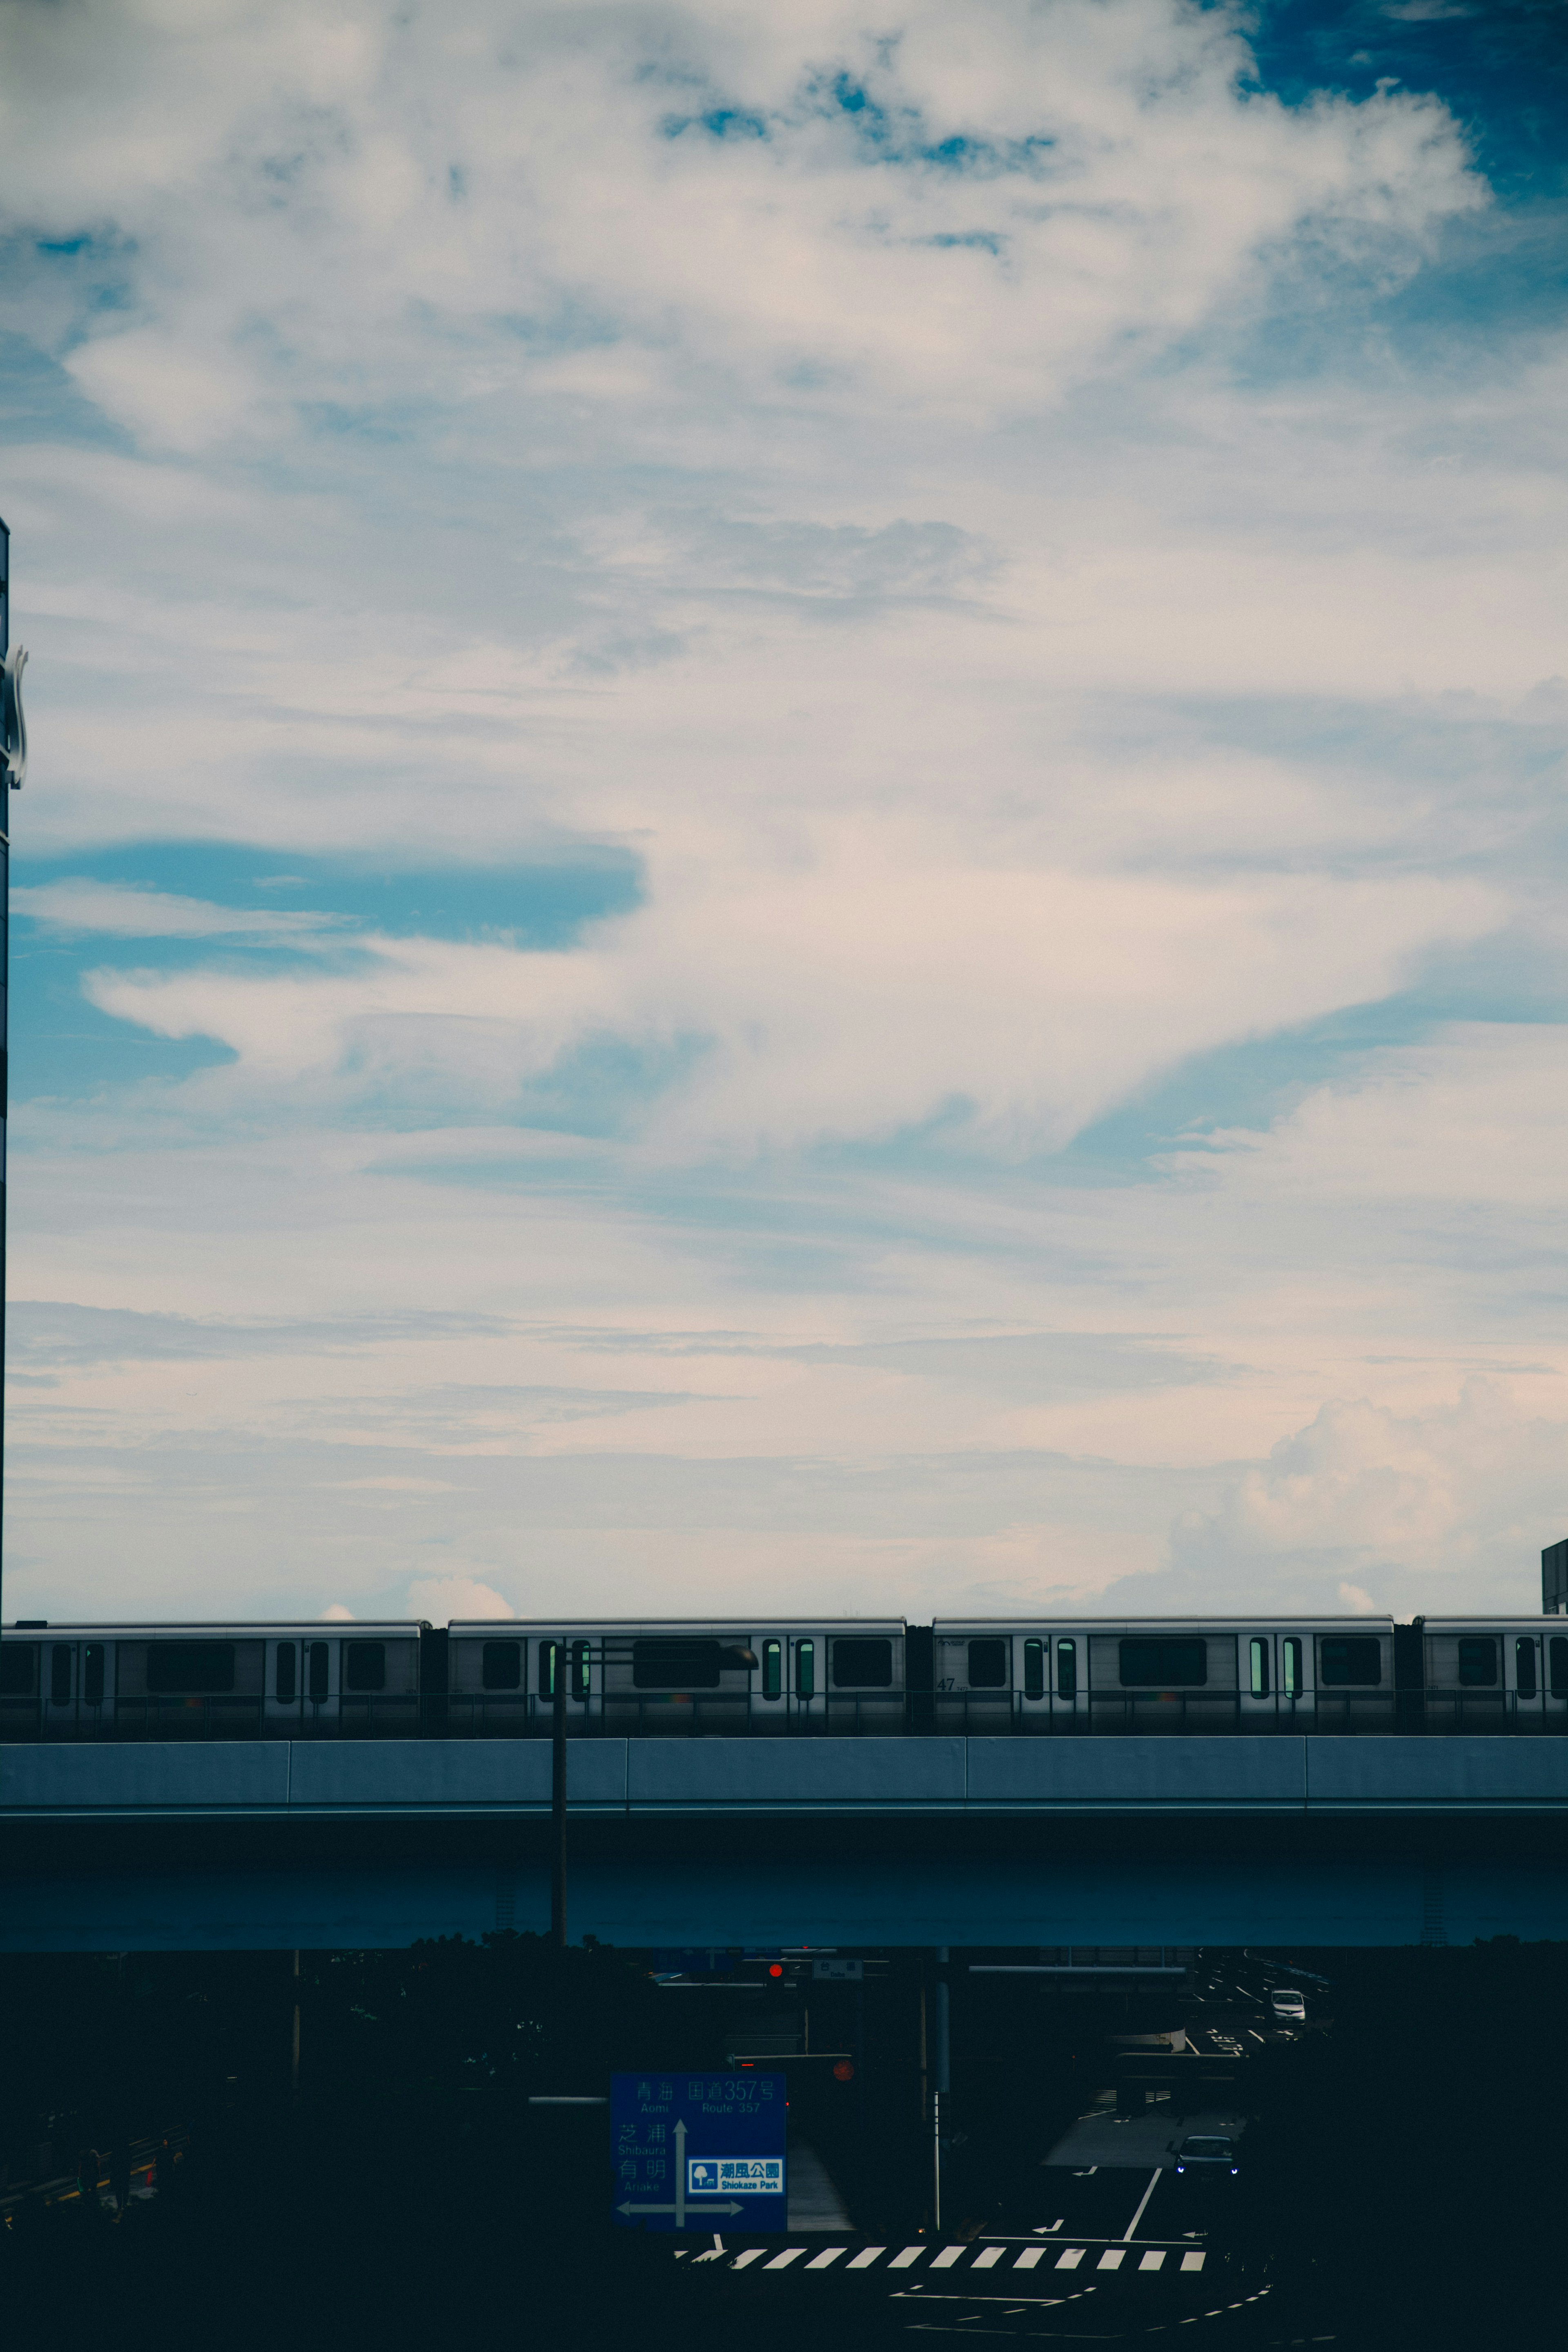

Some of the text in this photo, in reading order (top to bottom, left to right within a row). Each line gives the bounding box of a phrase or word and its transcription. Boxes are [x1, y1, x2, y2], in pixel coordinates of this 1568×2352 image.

[938, 1678, 955, 1690] 47
[637, 2082, 673, 2100] 青海
[688, 2081, 775, 2100] 国道357号
[641, 2103, 668, 2113] Aomi
[702, 2103, 760, 2113] Route 357
[619, 2124, 666, 2143] 芝浦
[618, 2146, 666, 2155] Shibaura
[619, 2160, 666, 2179] 有明
[721, 2163, 779, 2178] 潮風公園
[625, 2182, 659, 2192] Ariake
[722, 2180, 778, 2189] Shiokaze Park
